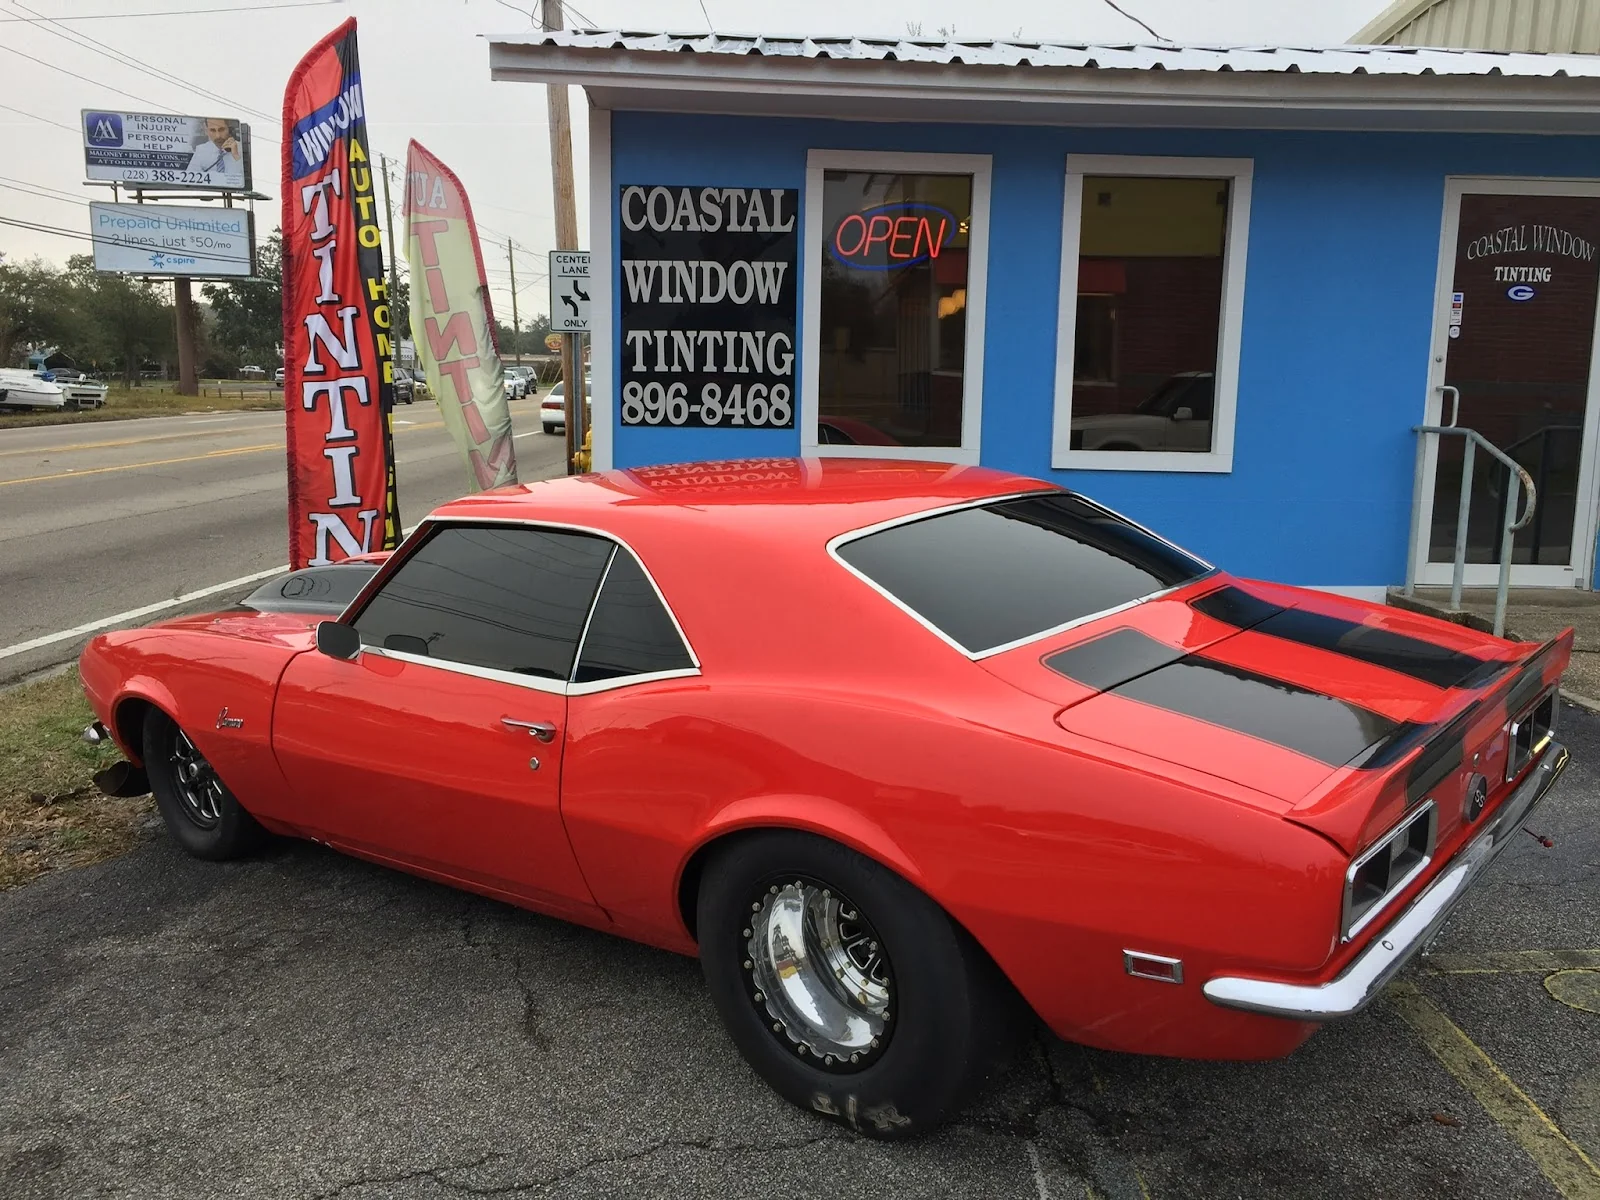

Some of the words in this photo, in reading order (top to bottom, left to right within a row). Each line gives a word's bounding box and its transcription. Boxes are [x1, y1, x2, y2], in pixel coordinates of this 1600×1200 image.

[126, 114, 187, 126] PERSONAL
[137, 123, 178, 132] INJURY
[298, 84, 363, 167] WINOW
[127, 133, 188, 144] PERSONAL
[89, 150, 123, 158] MALONEY
[143, 143, 174, 151] HELP
[97, 158, 149, 167] ATTORNEYS
[122, 169, 149, 180] (228)
[151, 170, 212, 185] 388-2224
[349, 138, 381, 248] AUTO
[621, 185, 796, 232] COASTAL
[99, 214, 162, 230] Prepaid
[166, 217, 241, 234] Unlimited
[111, 233, 121, 246] 2
[161, 236, 186, 248] just
[836, 214, 947, 258] OPEN
[1467, 224, 1528, 260] COASTAL
[1532, 224, 1596, 262] WINDOW
[556, 255, 591, 264] CENTE
[562, 266, 589, 274] LANE
[1494, 266, 1552, 282] TINTING
[622, 260, 789, 304] WINDOW
[1507, 285, 1535, 301] G
[563, 319, 588, 328] ONLY
[626, 330, 795, 376] TINTING
[622, 381, 792, 426] 896-8468
[1474, 789, 1486, 808] SS
